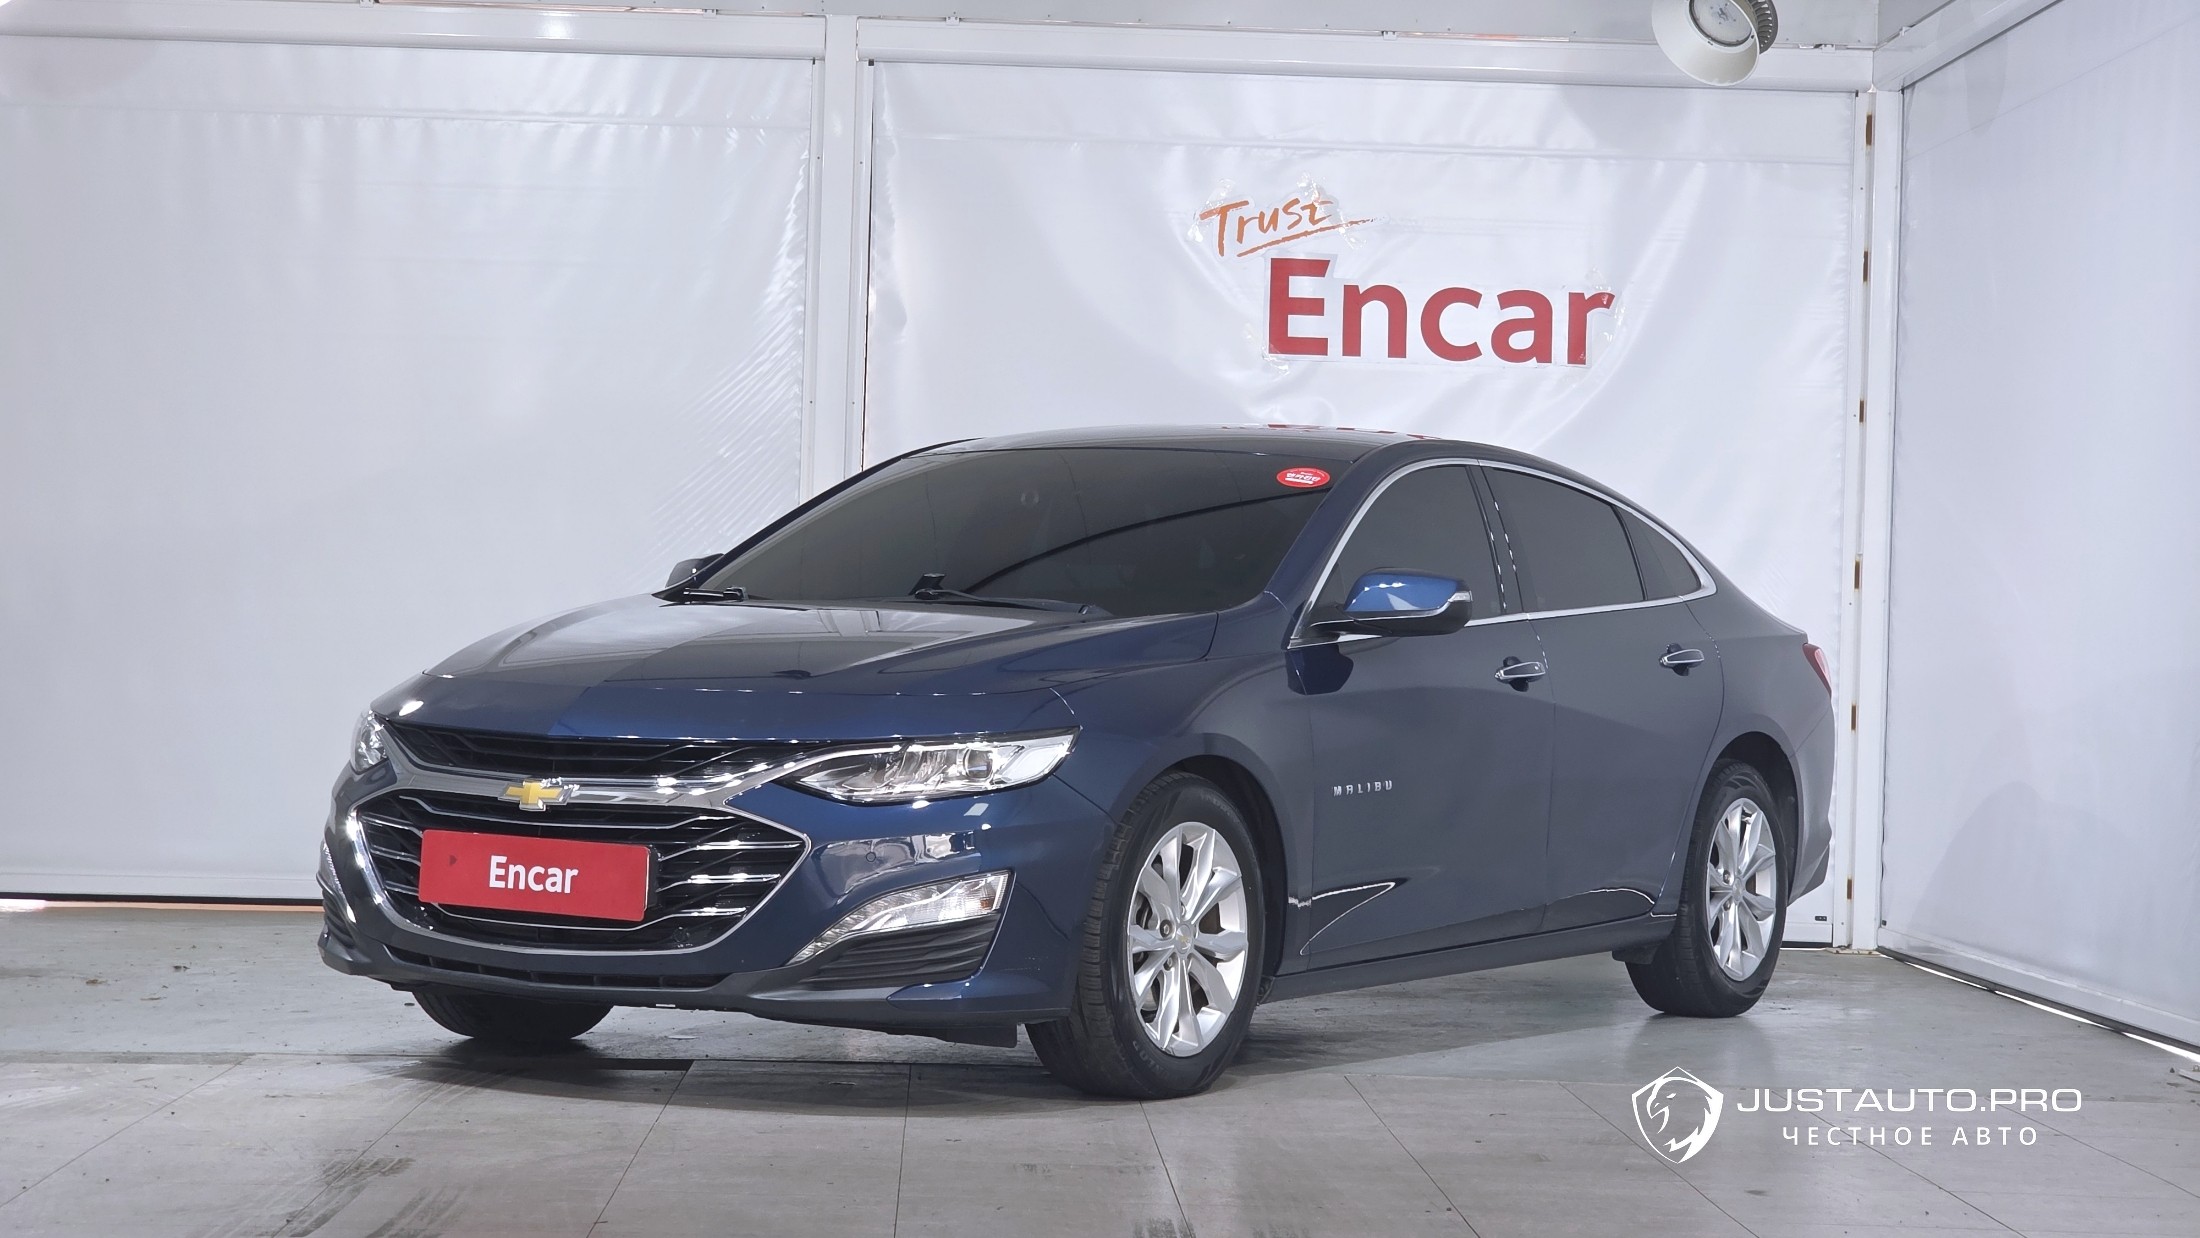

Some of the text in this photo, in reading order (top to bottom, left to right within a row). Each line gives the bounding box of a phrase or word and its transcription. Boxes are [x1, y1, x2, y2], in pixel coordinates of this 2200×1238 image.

[1200, 196, 1334, 258] Trust
[1268, 257, 1616, 366] Encar
[1333, 779, 1393, 797] MALIBU
[489, 854, 579, 894] Encar
